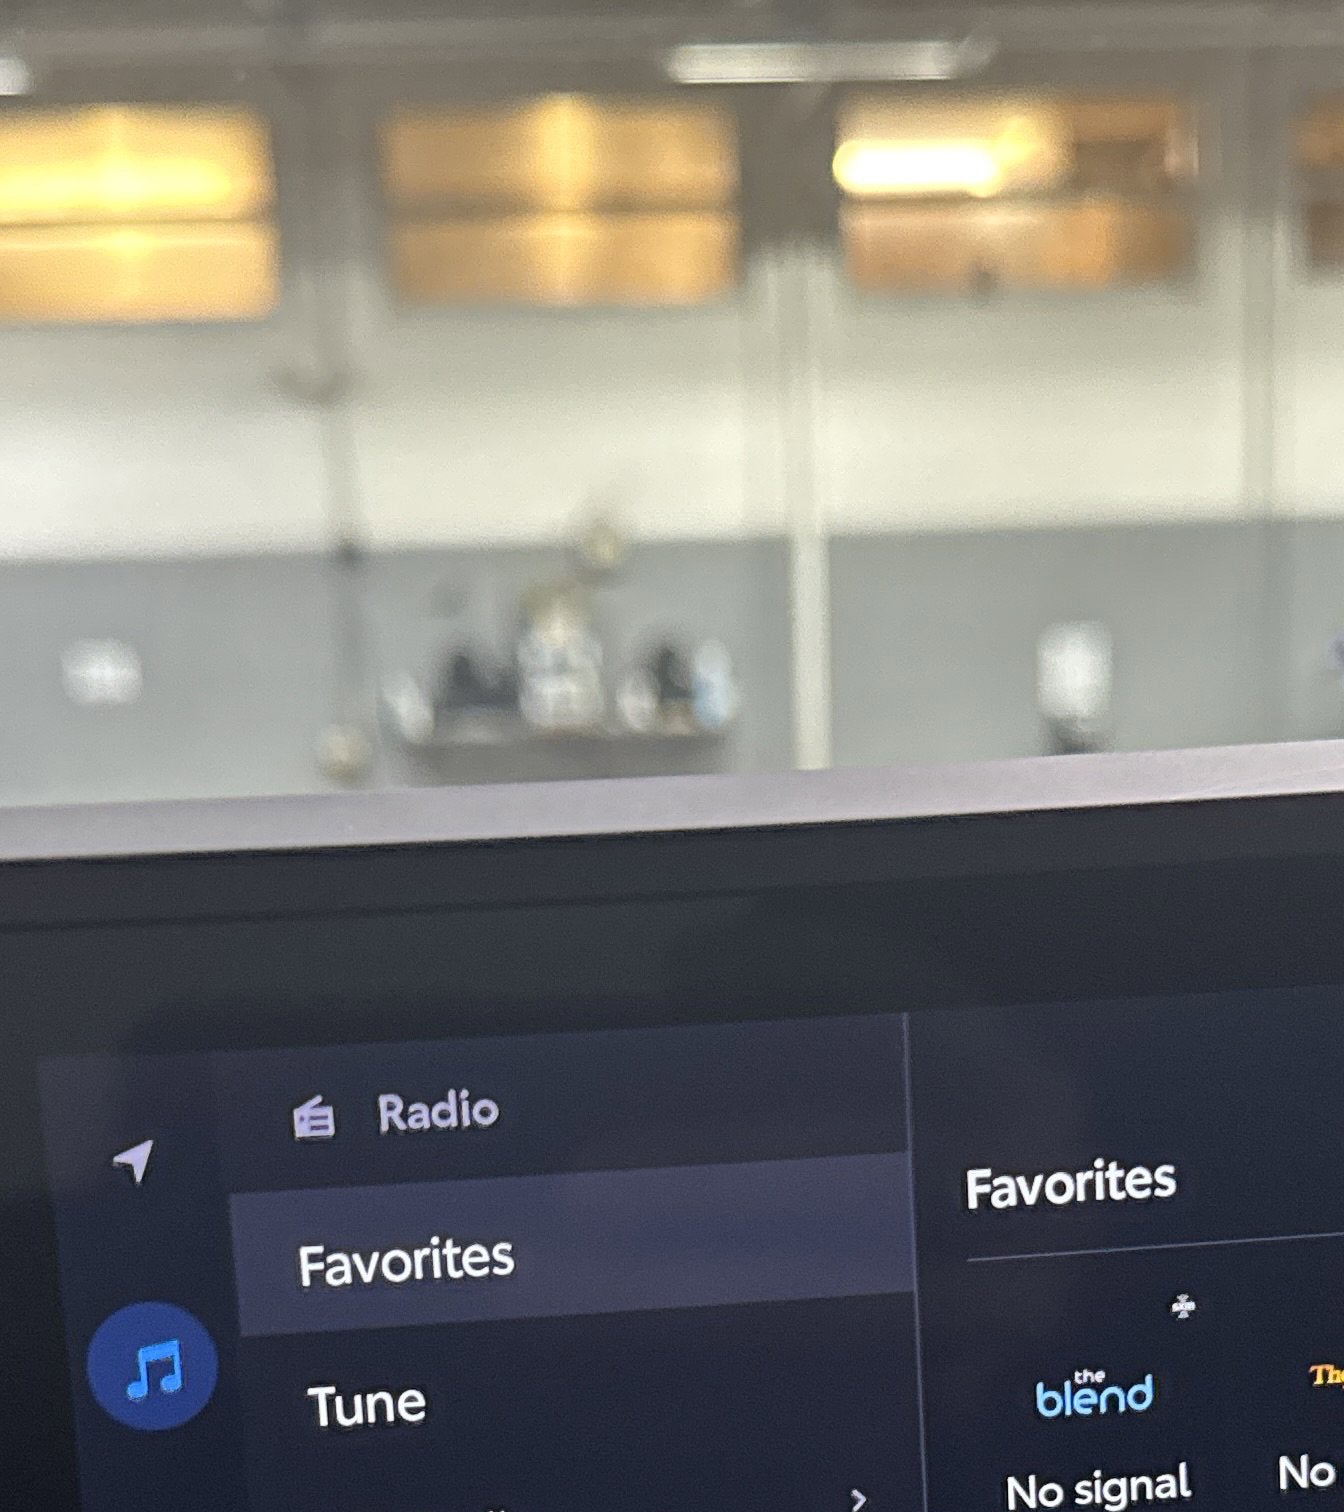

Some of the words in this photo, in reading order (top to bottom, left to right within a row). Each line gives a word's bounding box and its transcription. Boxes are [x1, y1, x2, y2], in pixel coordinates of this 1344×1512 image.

[377, 1087, 501, 1134] Radio
[965, 1156, 1178, 1212] Favorites
[298, 1234, 516, 1289] Favorites
[1035, 1373, 1155, 1418] blend
[1073, 1368, 1106, 1385] the
[306, 1383, 427, 1429] Tune
[1006, 1473, 1065, 1510] No
[1073, 1460, 1193, 1512] signal
[1278, 1453, 1337, 1490] No
